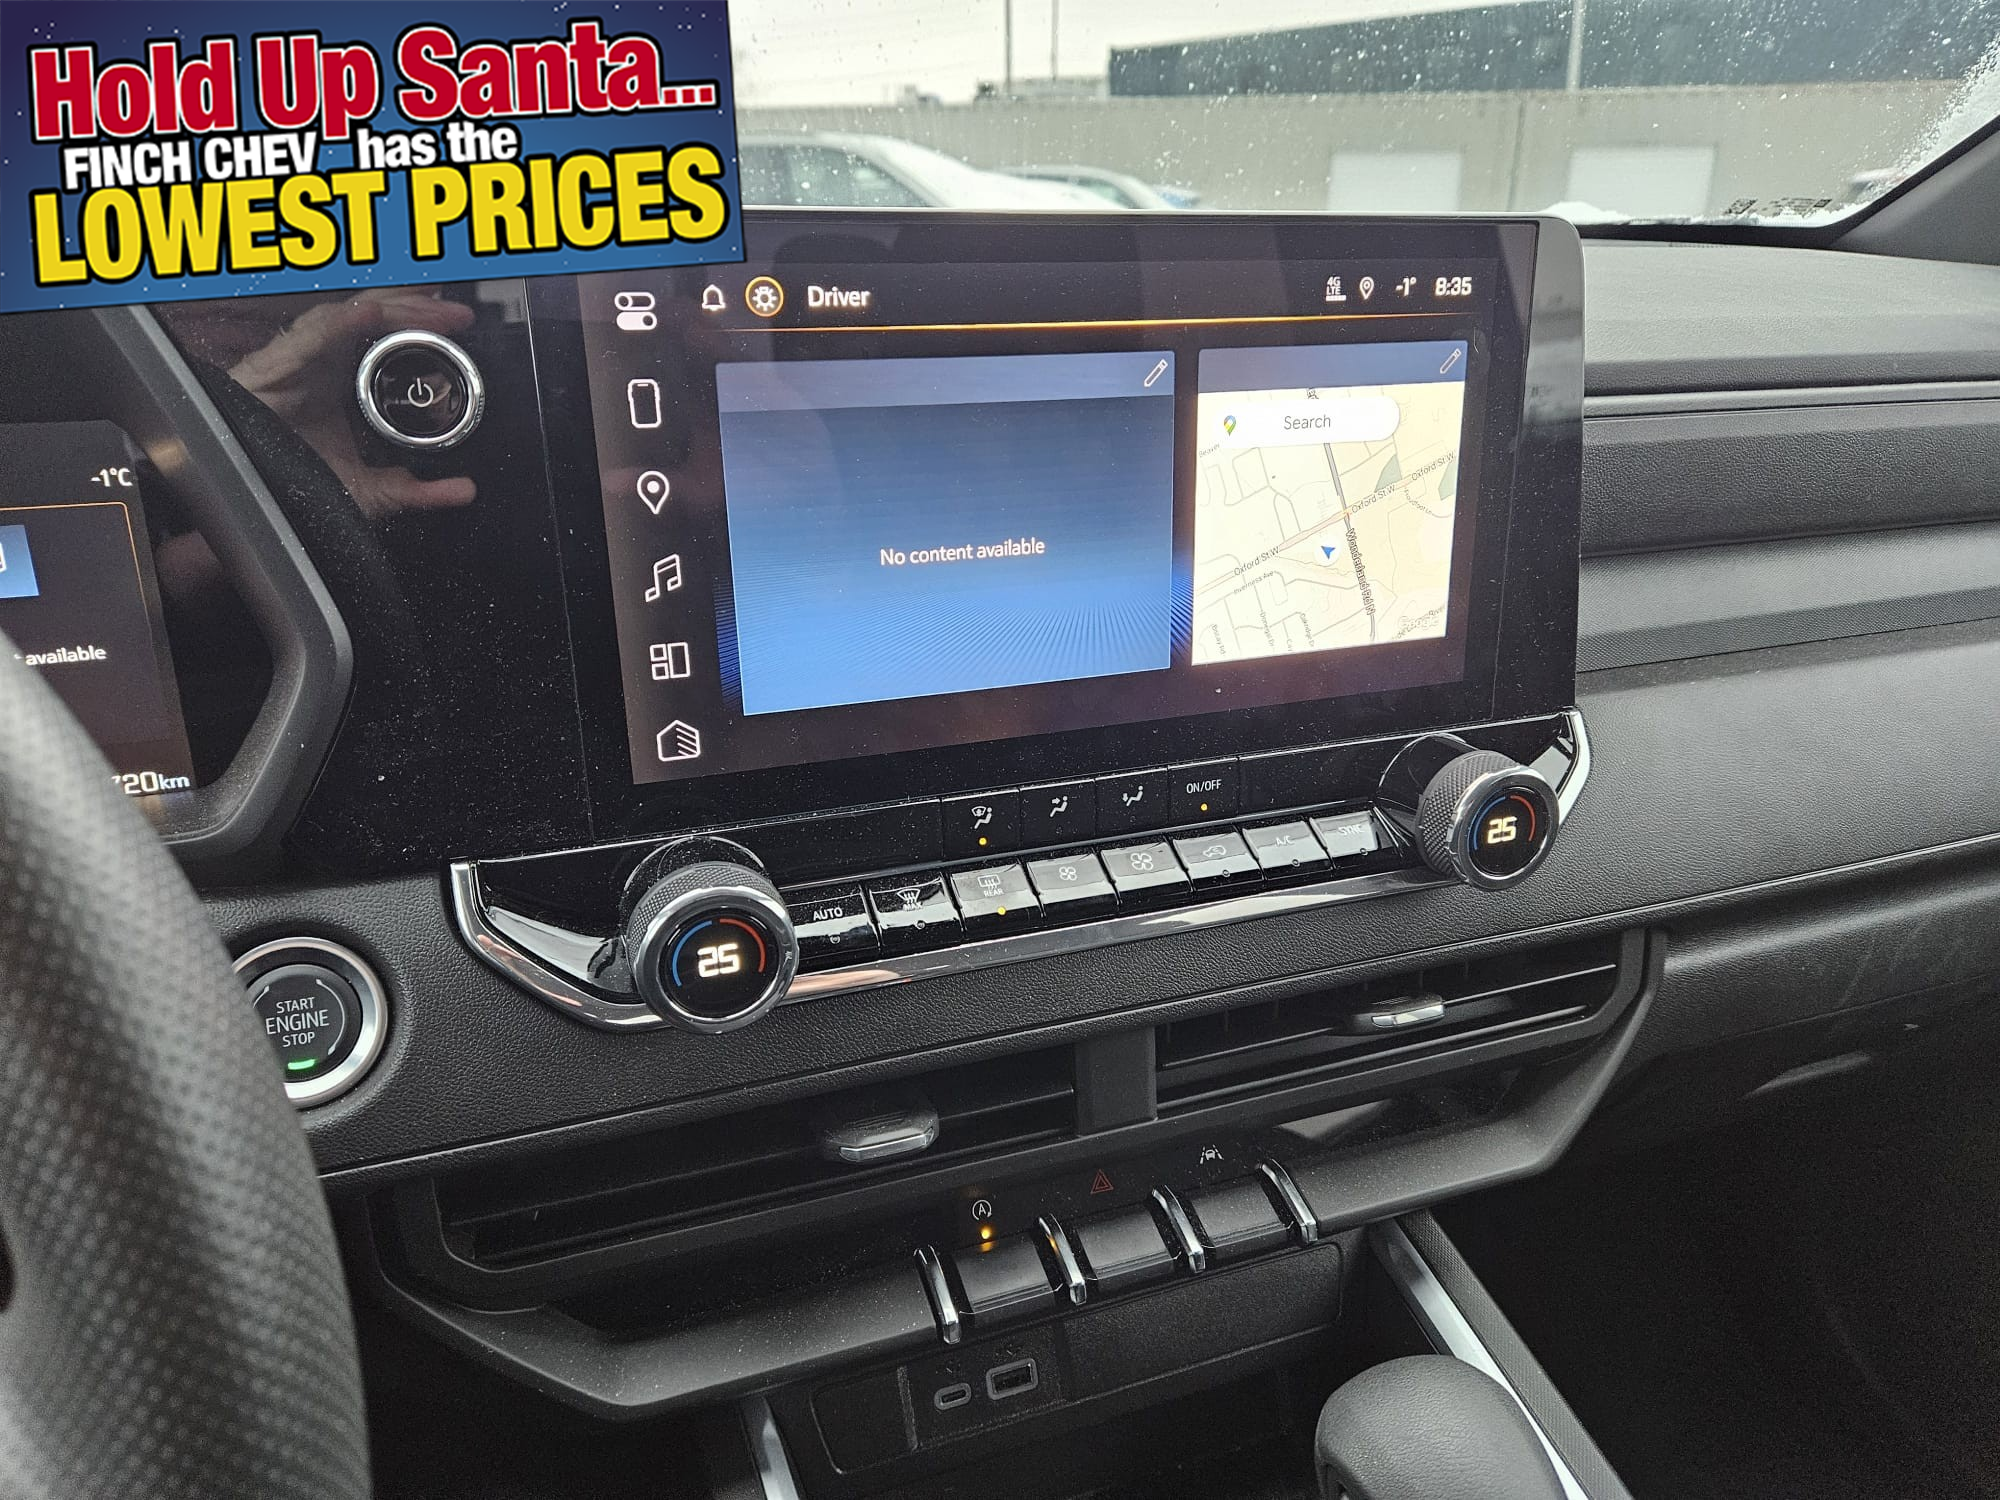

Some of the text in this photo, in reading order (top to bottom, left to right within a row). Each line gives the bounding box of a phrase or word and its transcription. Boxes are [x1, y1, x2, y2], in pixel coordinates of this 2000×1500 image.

[1326, 286, 1341, 295] LTE
[1327, 276, 1341, 286] 4G
[1435, 276, 1473, 296] 8:35
[807, 285, 871, 307] Driver
[1283, 414, 1331, 430] Search
[91, 467, 133, 487] -1°C
[1411, 461, 1437, 481] Oxford
[1351, 494, 1377, 513] Oxford
[880, 537, 1046, 566] No content available
[1233, 556, 1260, 576] Oxford
[25, 645, 107, 666] available
[1186, 779, 1222, 794] ON/OFF
[1487, 816, 1518, 844] 25
[813, 907, 843, 921] AUTO
[697, 942, 740, 978] 25
[276, 996, 315, 1014] START
[265, 1009, 329, 1035] ENGINE
[282, 1031, 315, 1047] STOP
